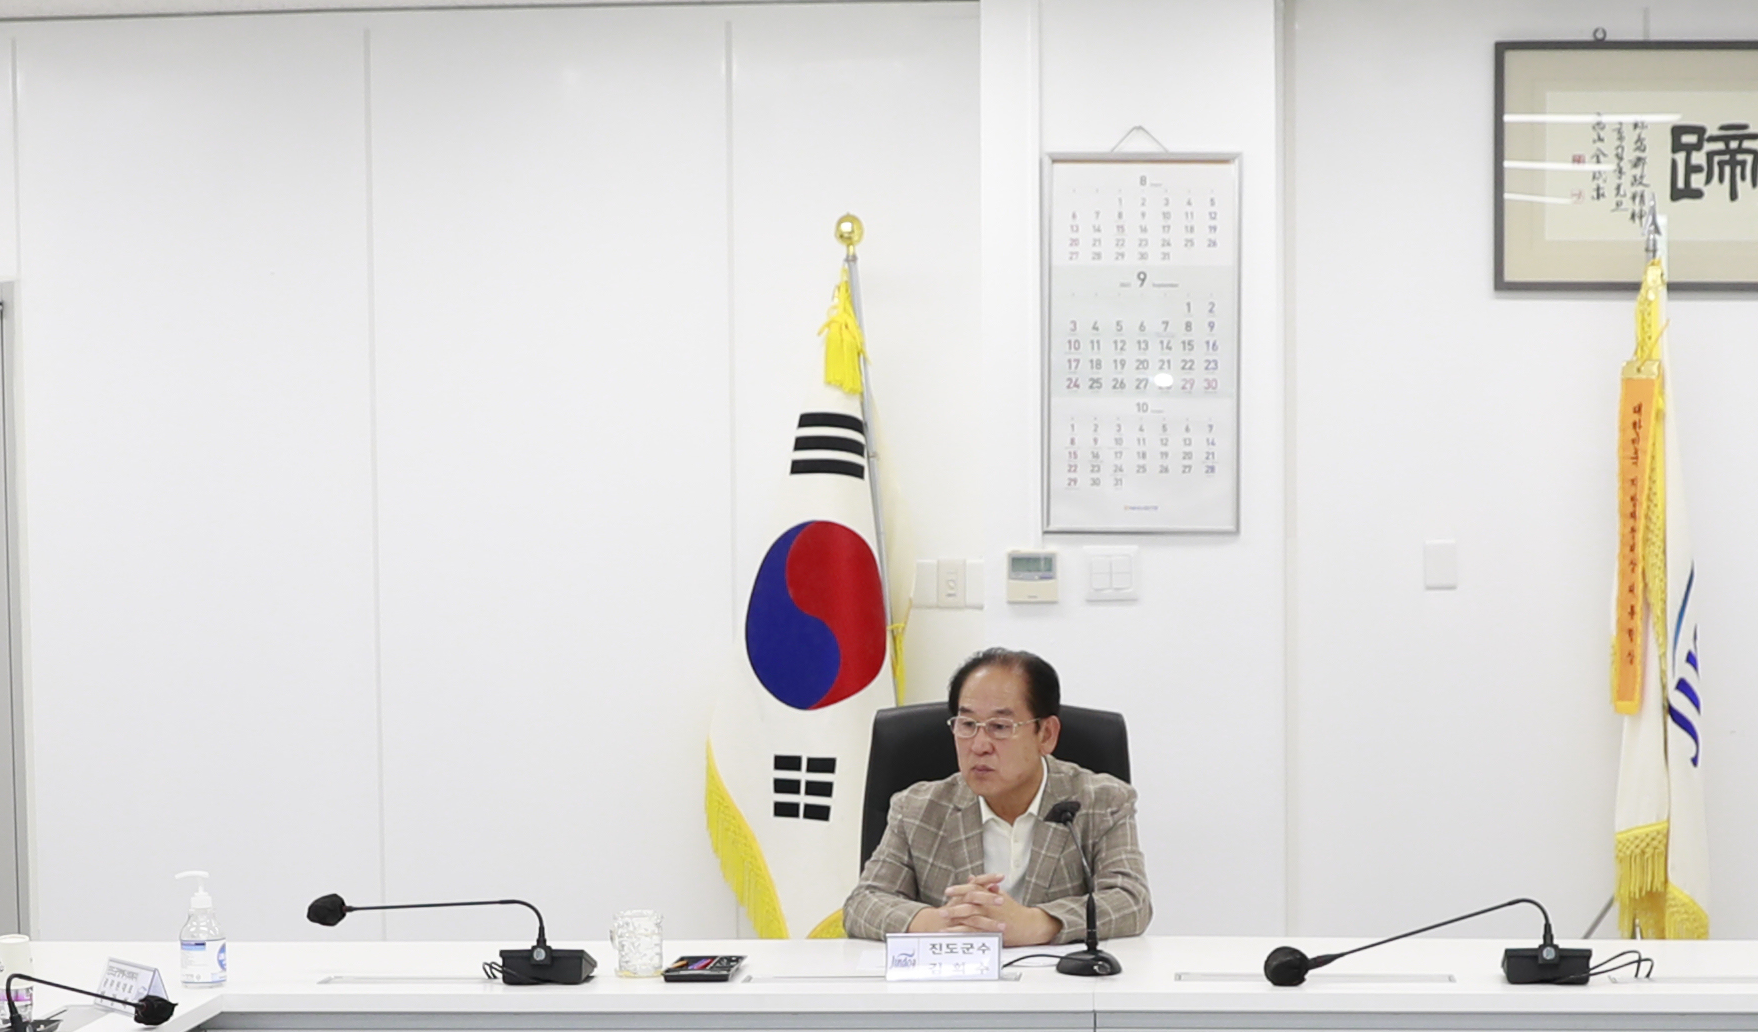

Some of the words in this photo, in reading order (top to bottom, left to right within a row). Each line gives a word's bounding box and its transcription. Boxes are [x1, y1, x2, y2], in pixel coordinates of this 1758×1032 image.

[1136, 271, 1148, 288] 9
[1185, 302, 1191, 315] 1
[1207, 301, 1215, 315] 2
[1069, 320, 1077, 334] 3
[1091, 321, 1099, 332] 4
[1115, 320, 1123, 334] 5
[1138, 321, 1146, 334] 6
[1161, 320, 1169, 334] 7
[1184, 321, 1192, 332] 8
[1207, 321, 1215, 334] 9
[1067, 339, 1081, 353] 10
[1089, 339, 1101, 353] 11
[1113, 339, 1126, 353] 12
[1136, 339, 1149, 353] 13
[1159, 339, 1172, 353] 14
[1181, 339, 1194, 352] 15
[1205, 340, 1218, 352] 16
[1067, 358, 1080, 372] 17
[1088, 358, 1102, 370] 18
[1113, 358, 1126, 370] 19
[1135, 359, 1149, 372] 20
[1157, 359, 1171, 372] 21
[1180, 359, 1195, 371] 22
[1204, 359, 1218, 372] 23
[1066, 377, 1080, 389] 24
[1088, 377, 1102, 390] 25
[1112, 378, 1126, 390] 26
[1135, 377, 1149, 391] 27
[1180, 377, 1195, 390] 29
[1203, 378, 1218, 391] 30
[1136, 402, 1149, 413] 10
[928, 942, 992, 955] 진도군수
